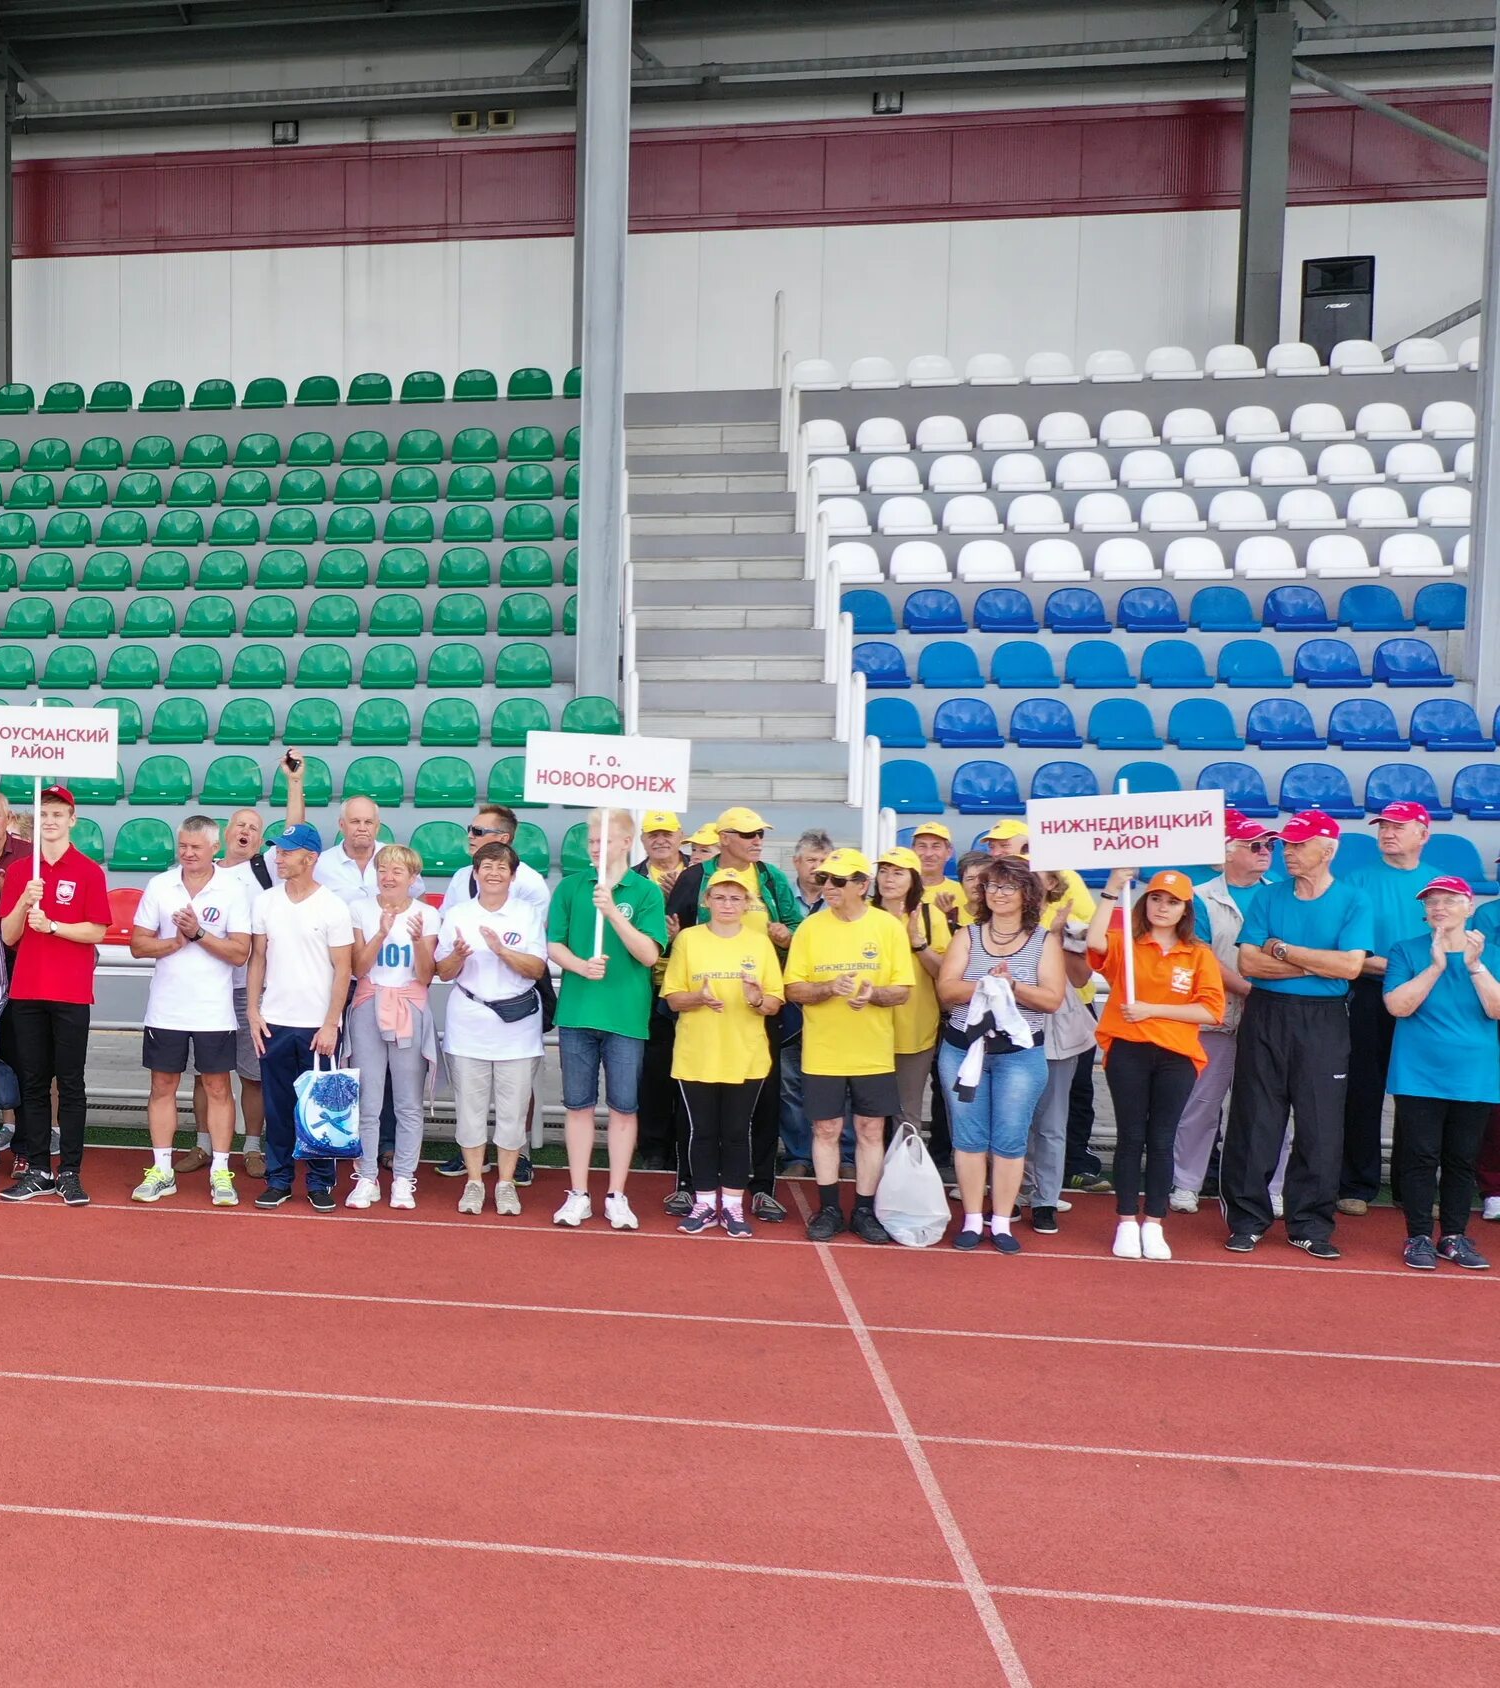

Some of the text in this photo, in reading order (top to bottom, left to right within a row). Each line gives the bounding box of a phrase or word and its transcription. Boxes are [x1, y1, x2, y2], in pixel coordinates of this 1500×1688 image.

[11, 743, 64, 759] РАЙОН
[589, 754, 621, 767] г. о.
[537, 769, 676, 793] НОВОВОРОНЕЖ
[1041, 810, 1213, 834] НИЖНЕДИВИЦКИЙ
[1093, 834, 1159, 851] РАЙОН
[377, 943, 411, 967] 101
